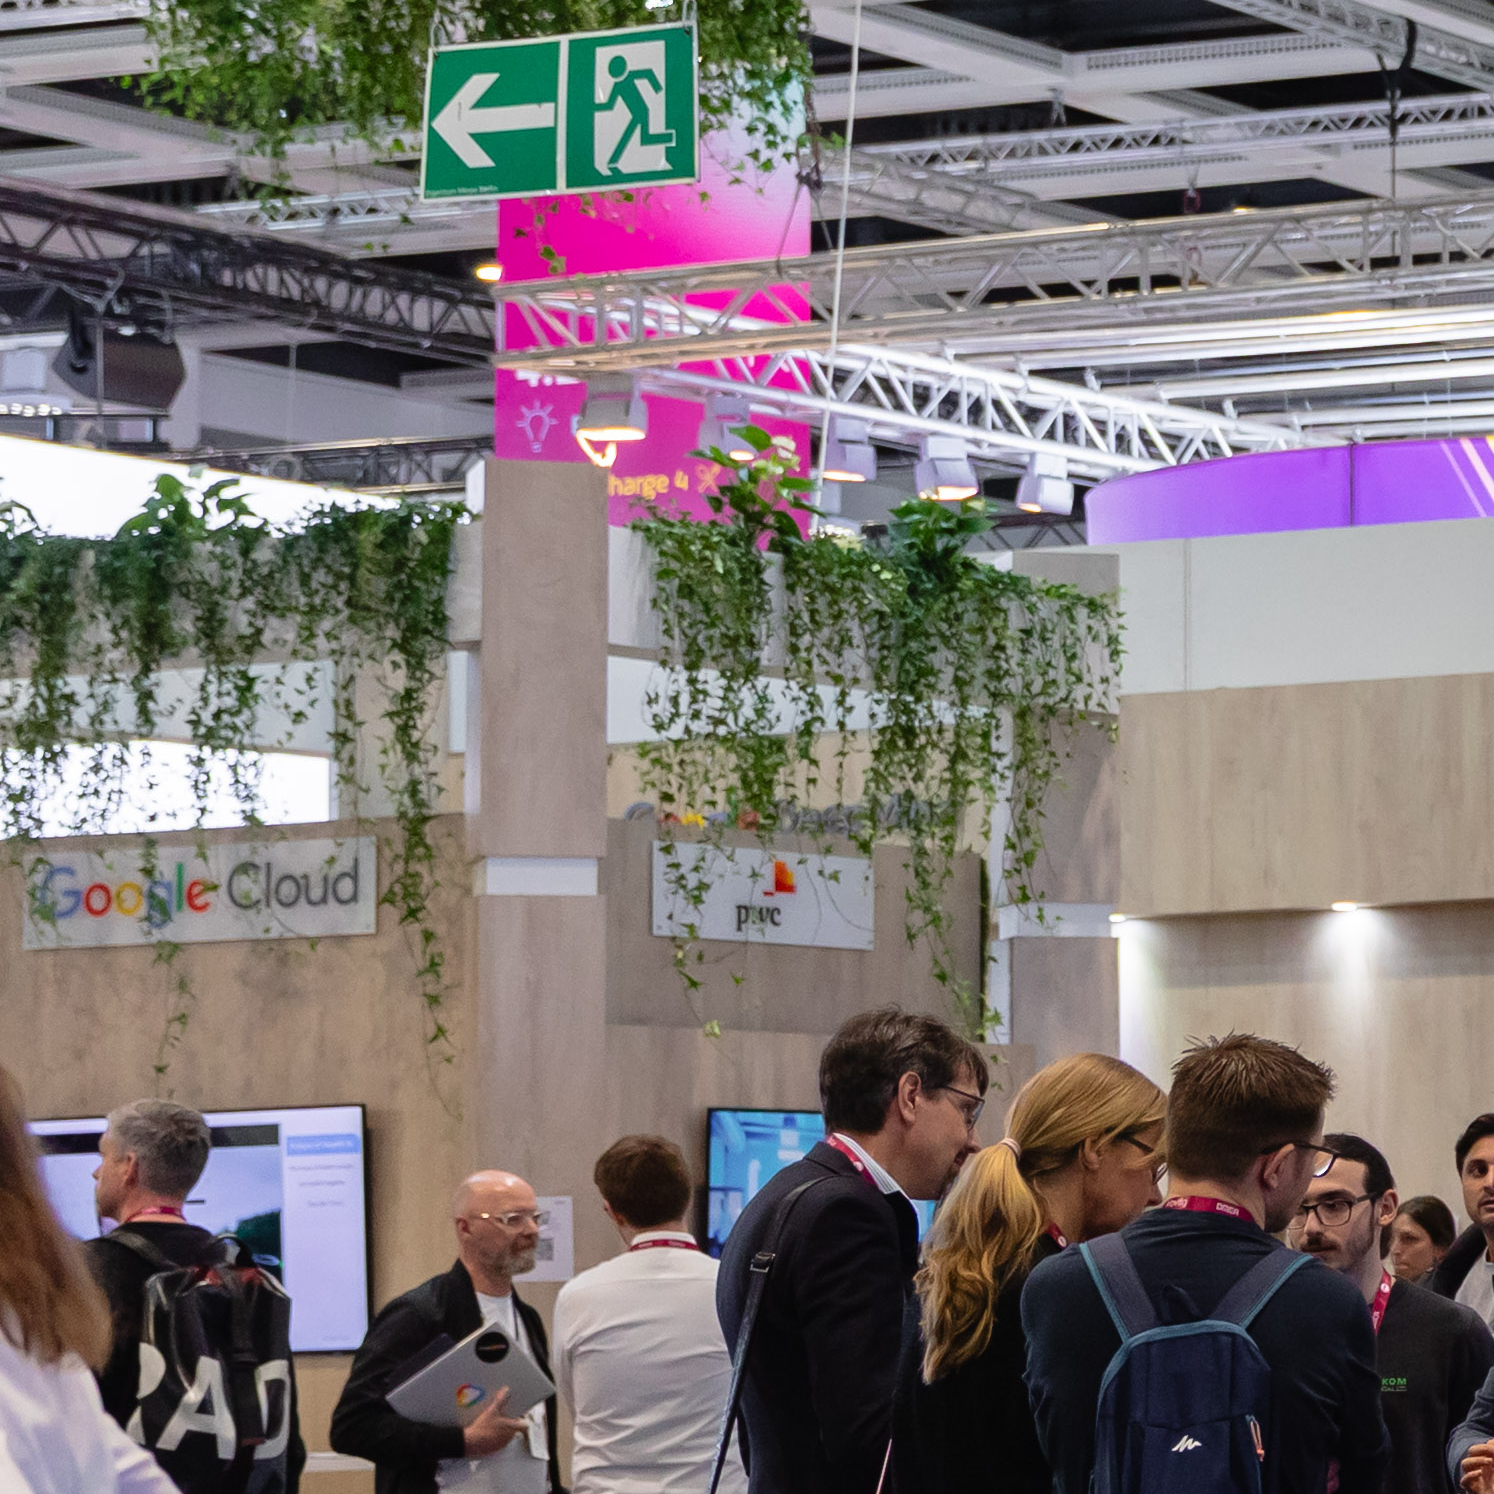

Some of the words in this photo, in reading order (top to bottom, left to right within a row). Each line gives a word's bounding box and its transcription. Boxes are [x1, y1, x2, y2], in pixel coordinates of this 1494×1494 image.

[608, 473, 669, 499] harge
[40, 858, 211, 922] Google
[227, 857, 361, 912] Cloud
